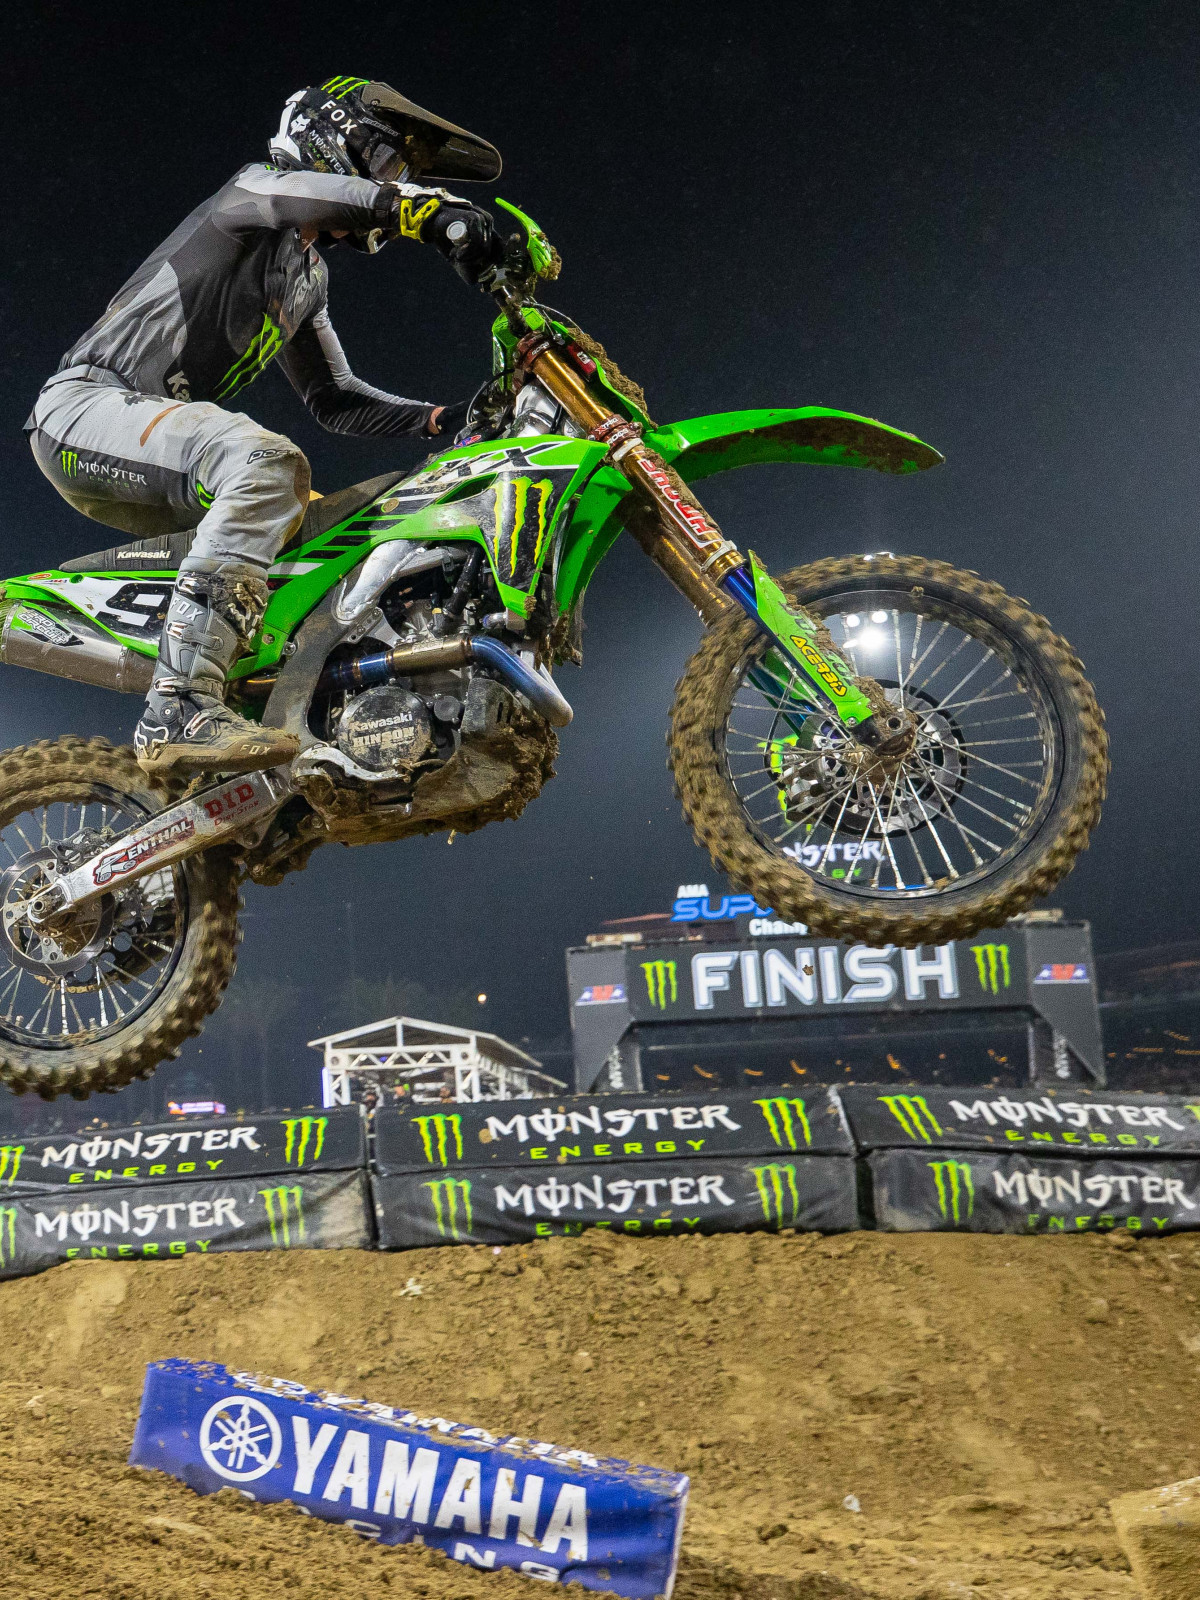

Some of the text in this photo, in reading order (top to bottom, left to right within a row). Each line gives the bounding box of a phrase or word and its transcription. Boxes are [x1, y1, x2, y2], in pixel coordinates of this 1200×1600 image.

[320, 100, 357, 135] FOX
[78, 460, 148, 486] MONSTER
[116, 549, 172, 560] Kawasaki
[349, 711, 414, 732] Kawasaki
[239, 744, 272, 756] FOX
[691, 940, 960, 1011] FINISH
[485, 1105, 742, 1142] MONSTER
[948, 1096, 1185, 1132] MONSTER
[41, 1126, 262, 1169] MONSTER
[529, 1139, 706, 1160] ENERGY
[1004, 1130, 1160, 1146] ENERGY
[68, 1159, 223, 1184] ENERGY
[992, 1168, 1197, 1210] MONSTER
[493, 1175, 736, 1217] MONSTER
[35, 1197, 245, 1241] MONSTER
[66, 1240, 213, 1260] ENERGY
[292, 1415, 588, 1562] YAMAHA
